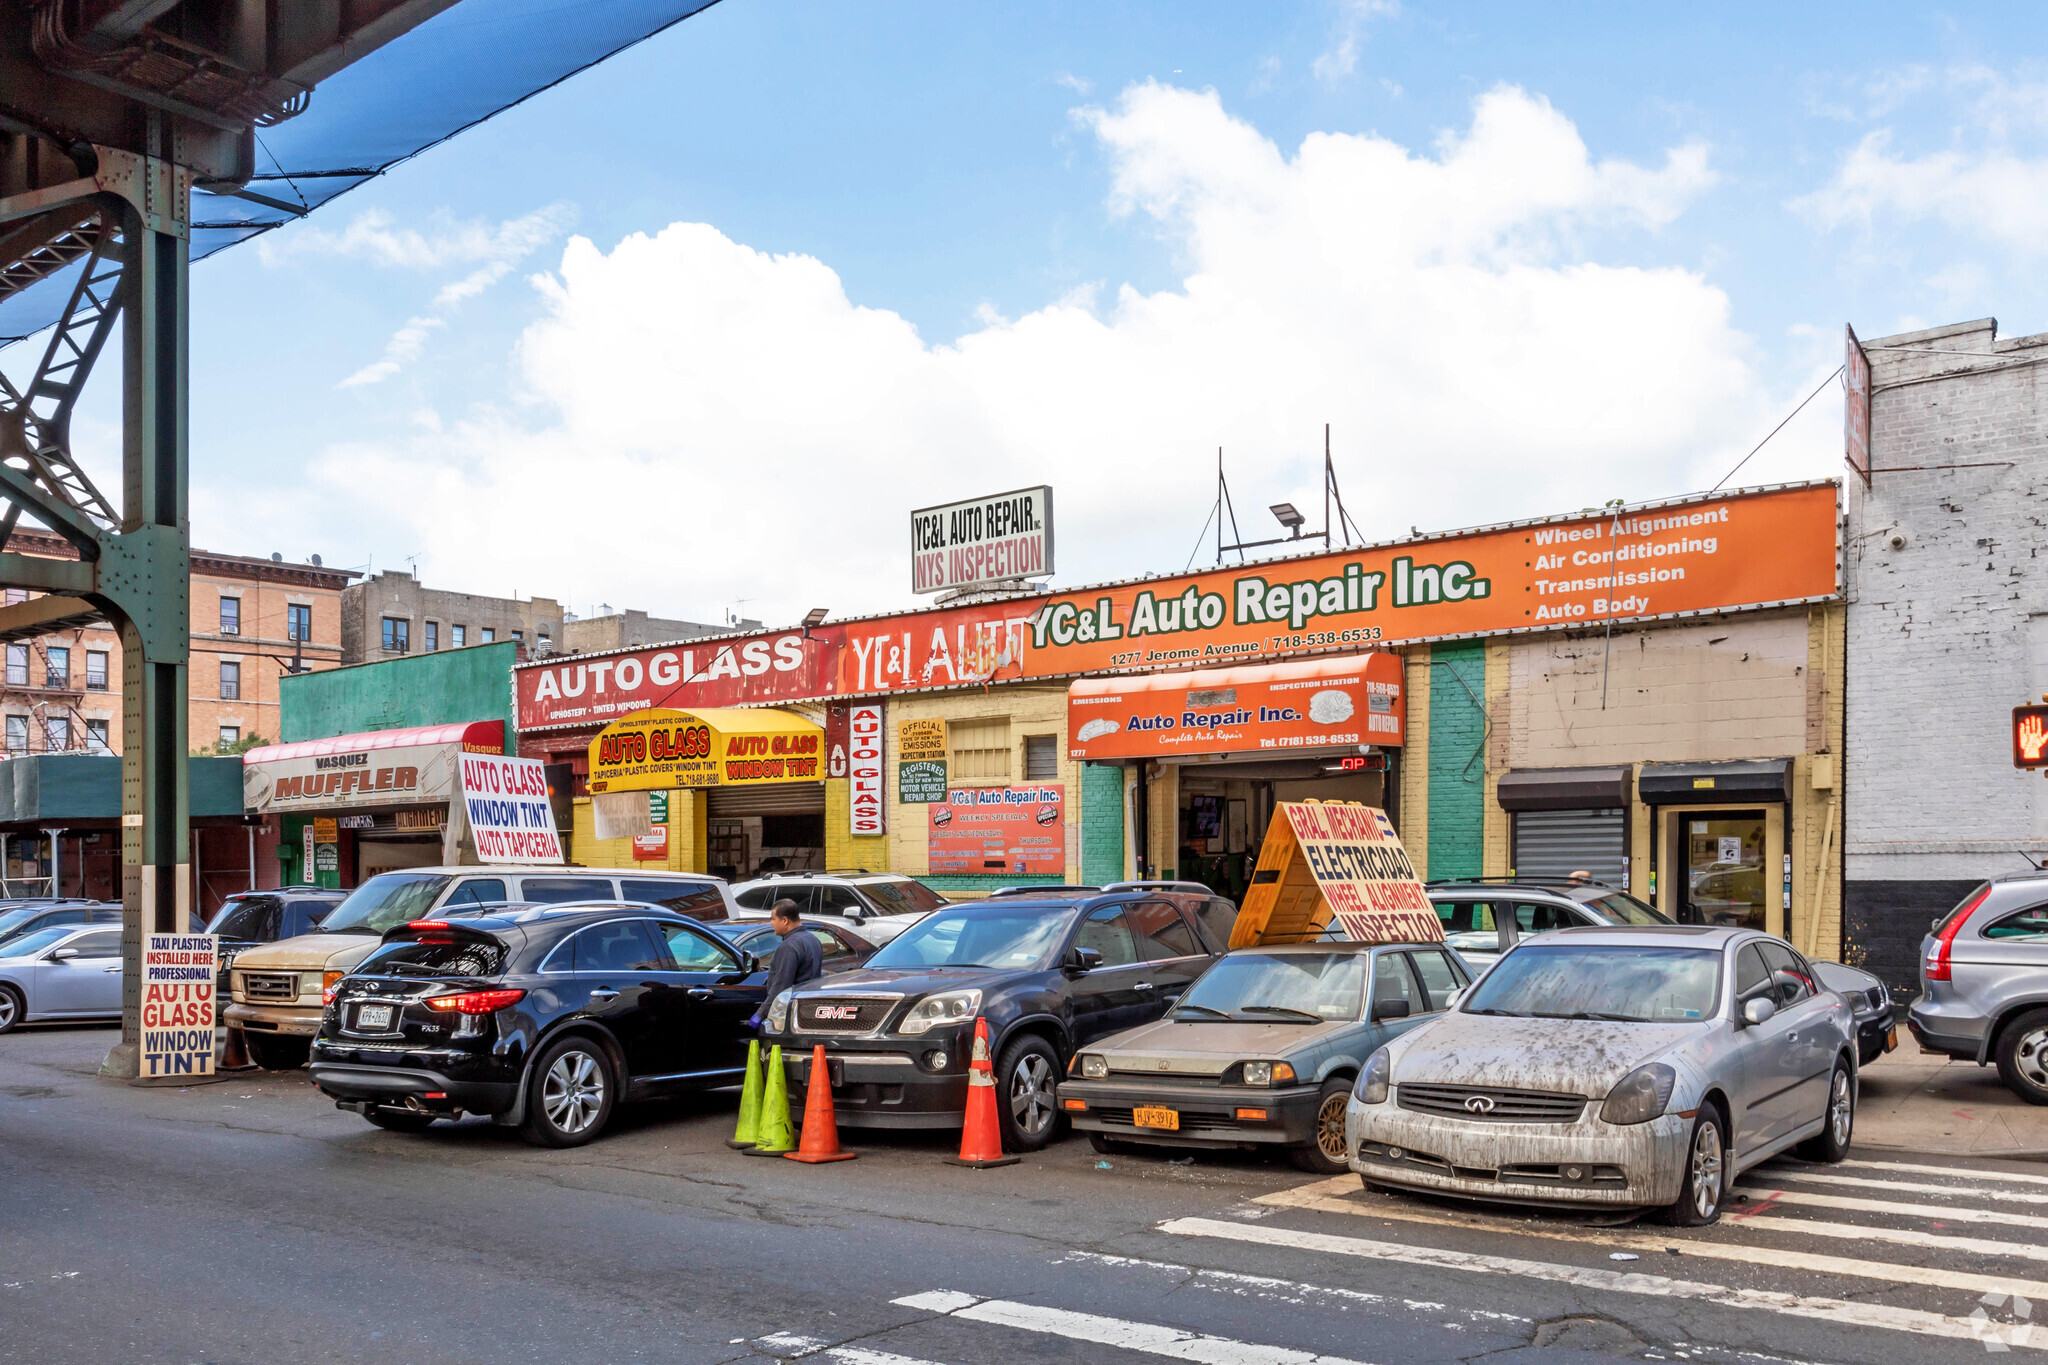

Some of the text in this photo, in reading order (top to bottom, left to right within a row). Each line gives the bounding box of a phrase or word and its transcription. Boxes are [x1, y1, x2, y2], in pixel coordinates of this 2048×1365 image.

[915, 496, 1042, 551] YC&L AUTO REPAIR INC.
[1535, 506, 1729, 546] Wheel Alignment
[916, 535, 1042, 589] NYS INSPECTION
[1535, 536, 1718, 570] Air Conditioning
[1535, 566, 1685, 595] Transmission
[1033, 556, 1490, 649] YC&L Auto Repair Inc.
[1535, 596, 1649, 620] Auto Body
[1110, 651, 1141, 666] 1277
[1145, 646, 1199, 662] Jerome
[1204, 640, 1259, 657] Avenue
[1272, 627, 1382, 649] 718-538-6533
[535, 635, 803, 702] AUTO GLASS
[1072, 677, 1360, 705] EMISSIONS INSPECTION STATION
[550, 699, 651, 720] UPHOSTERY TINTED WINDOWS
[1127, 707, 1303, 731] Auto Repair Inc.
[902, 721, 942, 735] OFFICIAL
[1368, 714, 1399, 734] AUTO REPAIR
[464, 742, 502, 754] Vasquez
[599, 725, 711, 765] AUTO GLASS
[726, 735, 818, 756] AUTO GLASS
[903, 740, 942, 750] EMISSIONS
[1159, 730, 1243, 745] Complete Auto Repair
[1260, 733, 1359, 748] Tel. (718) 538-6533
[316, 752, 368, 772] VASQUEZ
[900, 750, 945, 760] INSPECTION STATION
[1070, 749, 1086, 757] 1277
[702, 760, 717, 770] TINT
[726, 757, 817, 780] WINDOW TINT
[852, 709, 880, 831] AUTO GLASS
[901, 762, 945, 778] REGISTERED
[274, 766, 418, 801] MUFFLER
[465, 758, 546, 797] AUTO GLASS
[900, 783, 945, 793] MOTOR VEHICLE
[904, 792, 942, 802] REPAIR SHOP
[979, 788, 1001, 804] Auto
[1004, 789, 1037, 807] Repair
[1039, 788, 1060, 802] Inc.
[468, 798, 547, 828] WINDOW TINT
[960, 812, 1028, 822] WEEKLY SPECIALS
[1288, 805, 1385, 842] GRAL. MECHANIC
[476, 829, 560, 858] AUTO TAPICERIA
[1019, 837, 1052, 845] THURSDAYS
[1306, 845, 1415, 880] ELECTRICIDAD
[1321, 883, 1429, 912] WHEEL ALIGNMENT
[1340, 913, 1447, 942] INSPECTION
[151, 937, 213, 950] TAXI PLASTICS
[147, 952, 213, 965] INSTALLED HERE
[149, 967, 211, 980] PROFESSIONAL
[147, 984, 211, 1003] AUTO
[144, 1002, 212, 1028] GLASS
[815, 1006, 858, 1020] GMC
[421, 1024, 440, 1032] FX35
[145, 1030, 212, 1053] WINDOW
[145, 1051, 212, 1075] TINT
